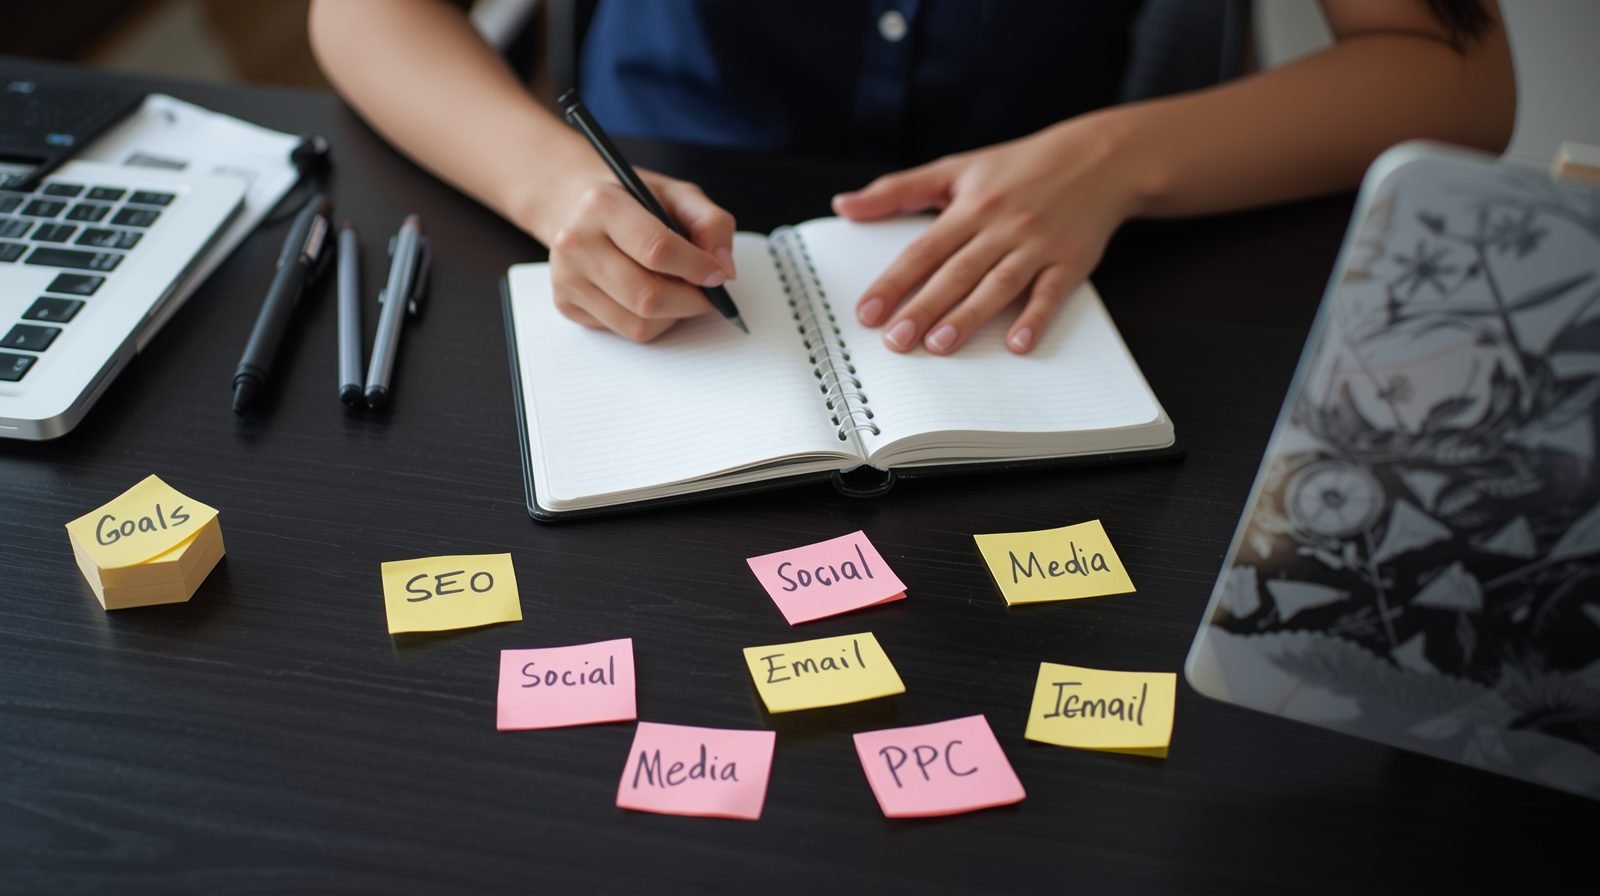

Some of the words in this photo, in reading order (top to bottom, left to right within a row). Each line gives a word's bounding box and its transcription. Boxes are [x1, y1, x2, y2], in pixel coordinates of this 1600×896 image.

[95, 503, 191, 547] Goals
[777, 543, 875, 592] Social
[1008, 540, 1112, 585] Media
[405, 570, 494, 604] SEO
[521, 655, 616, 688] Social
[760, 638, 867, 685] Email
[631, 742, 738, 789] Media
[879, 740, 979, 788] PPC
